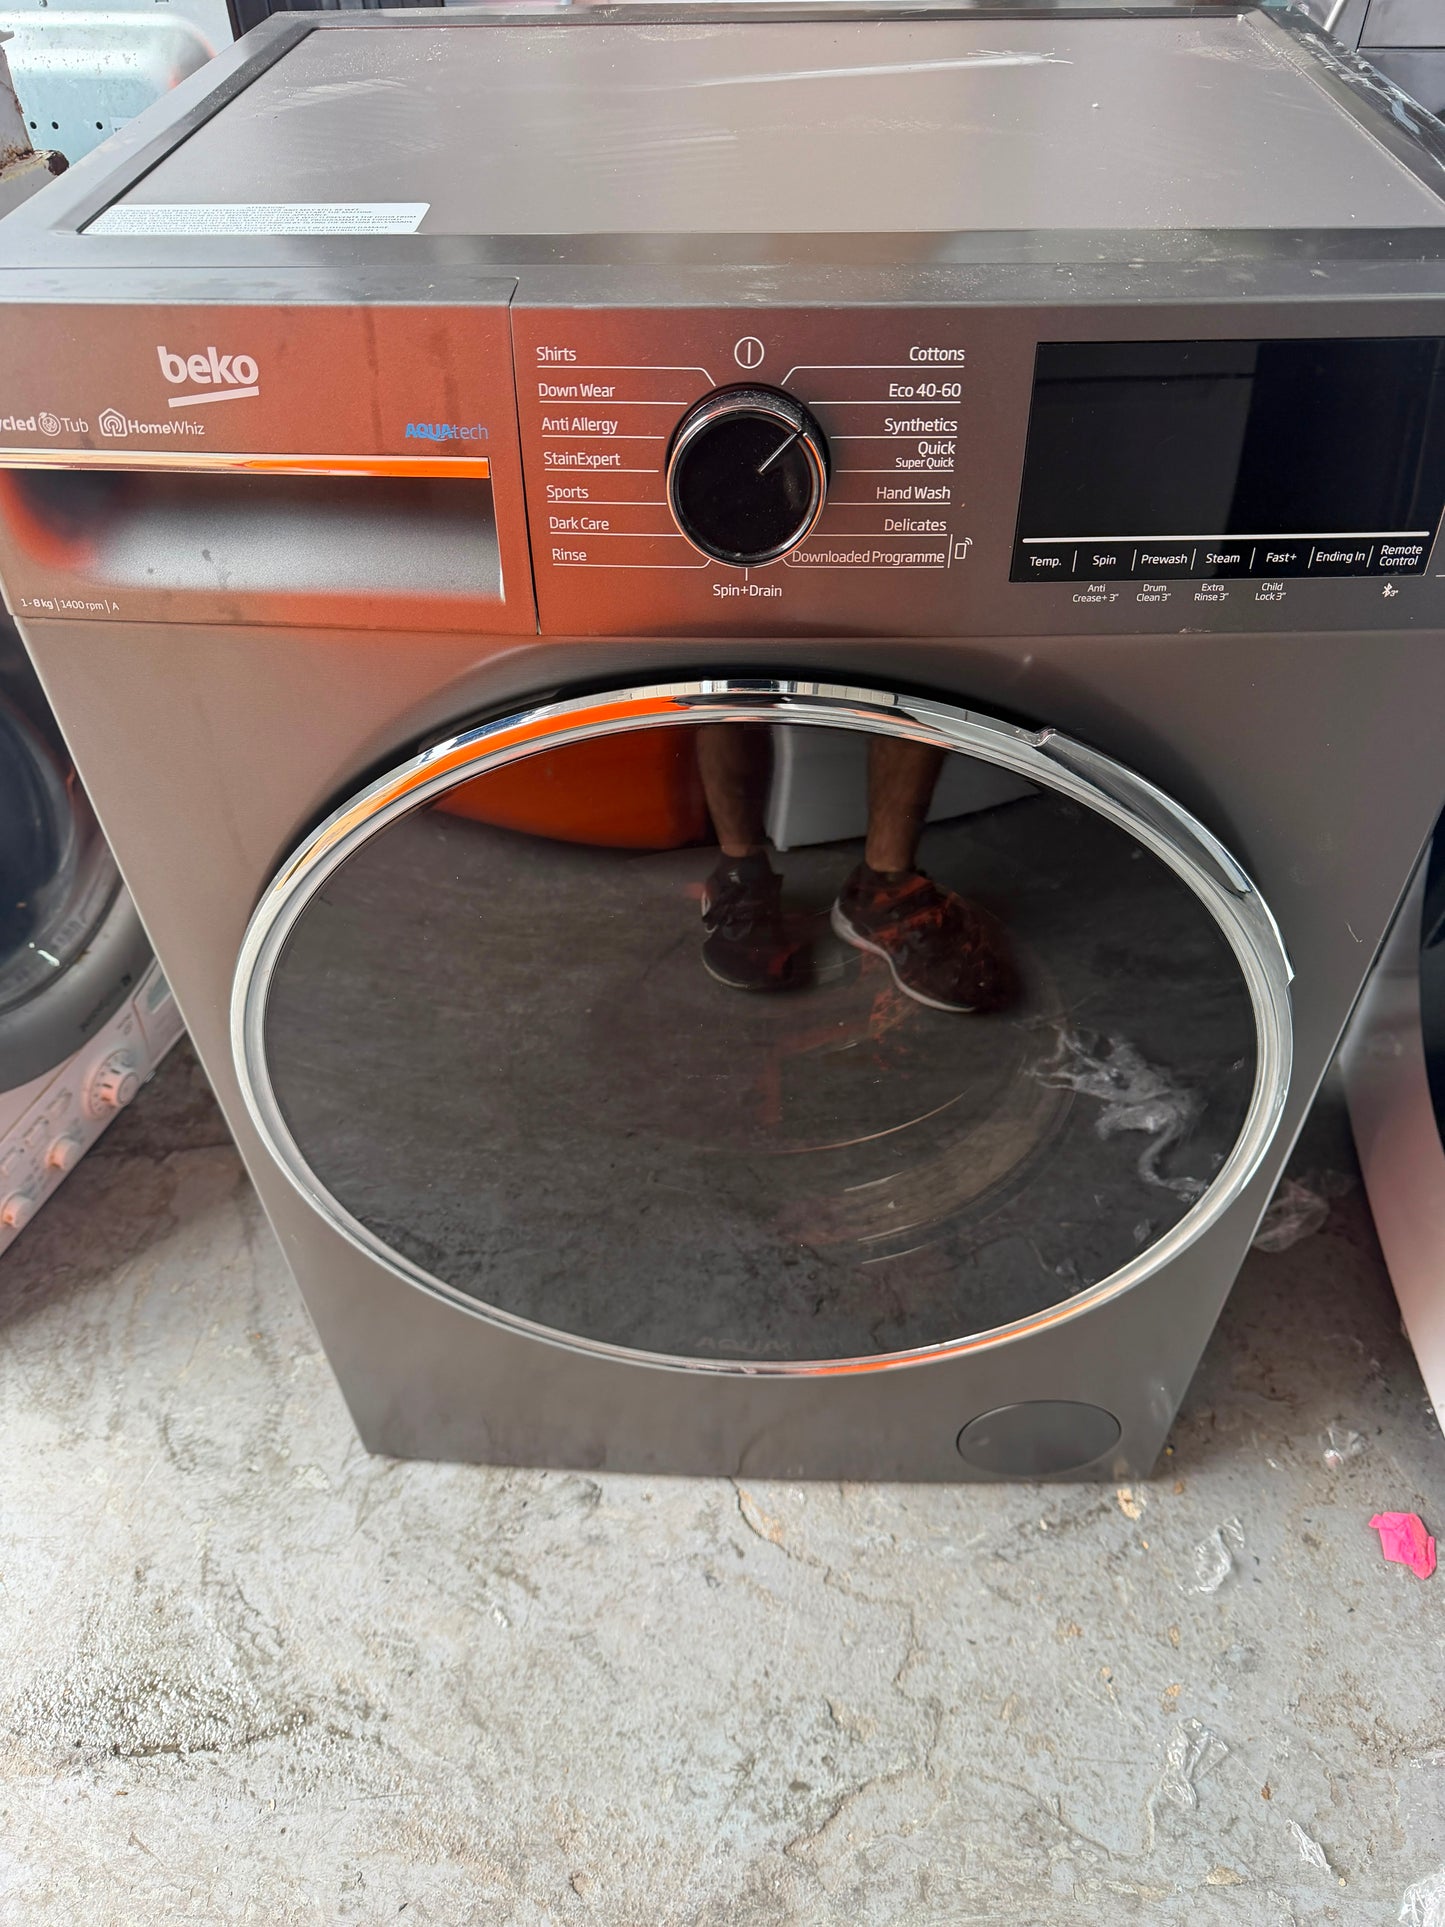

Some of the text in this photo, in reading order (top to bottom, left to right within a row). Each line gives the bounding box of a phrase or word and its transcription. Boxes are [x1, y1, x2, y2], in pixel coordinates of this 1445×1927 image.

[536, 346, 576, 361] Shirts
[909, 346, 965, 361] Cottons
[157, 346, 260, 384] beko
[538, 383, 615, 397] Down Wear
[889, 383, 961, 397] Eco 40-60
[0, 416, 89, 432] cled Tub
[127, 420, 205, 435] HomeWhiz
[542, 417, 618, 435] Anti Allergy
[884, 417, 958, 435] Synthetics
[405, 423, 488, 442] AQUAtech
[918, 441, 956, 457] Quick
[543, 451, 621, 468] StainExpert
[895, 456, 954, 469] Super Quick
[546, 485, 589, 500] Sports
[876, 486, 951, 499] Hand Wash
[549, 516, 609, 530] Dark Care
[884, 518, 947, 531] Delicates
[552, 548, 587, 561] Rinse
[1380, 545, 1423, 555] Remote
[792, 550, 945, 566] Downloaded Programme
[1030, 556, 1061, 568] Temp.
[1093, 555, 1116, 567] Spin
[1141, 554, 1188, 564] Prewash
[1205, 553, 1240, 563] Steam
[1266, 552, 1297, 562] Fast+
[1316, 551, 1365, 564] Ending In
[1379, 555, 1419, 566] Control
[713, 580, 782, 598] Spin+Drain
[1087, 584, 1106, 592] Anti
[1143, 584, 1167, 592] Drum
[1201, 583, 1224, 591] Extra
[1262, 582, 1283, 591] Child
[1072, 594, 1107, 602] Crease+
[1136, 593, 1160, 602] Clean
[1194, 593, 1218, 601] Rinse
[1255, 592, 1275, 601] Lock
[60, 600, 104, 611] 1400 rpm
[112, 602, 119, 610] A
